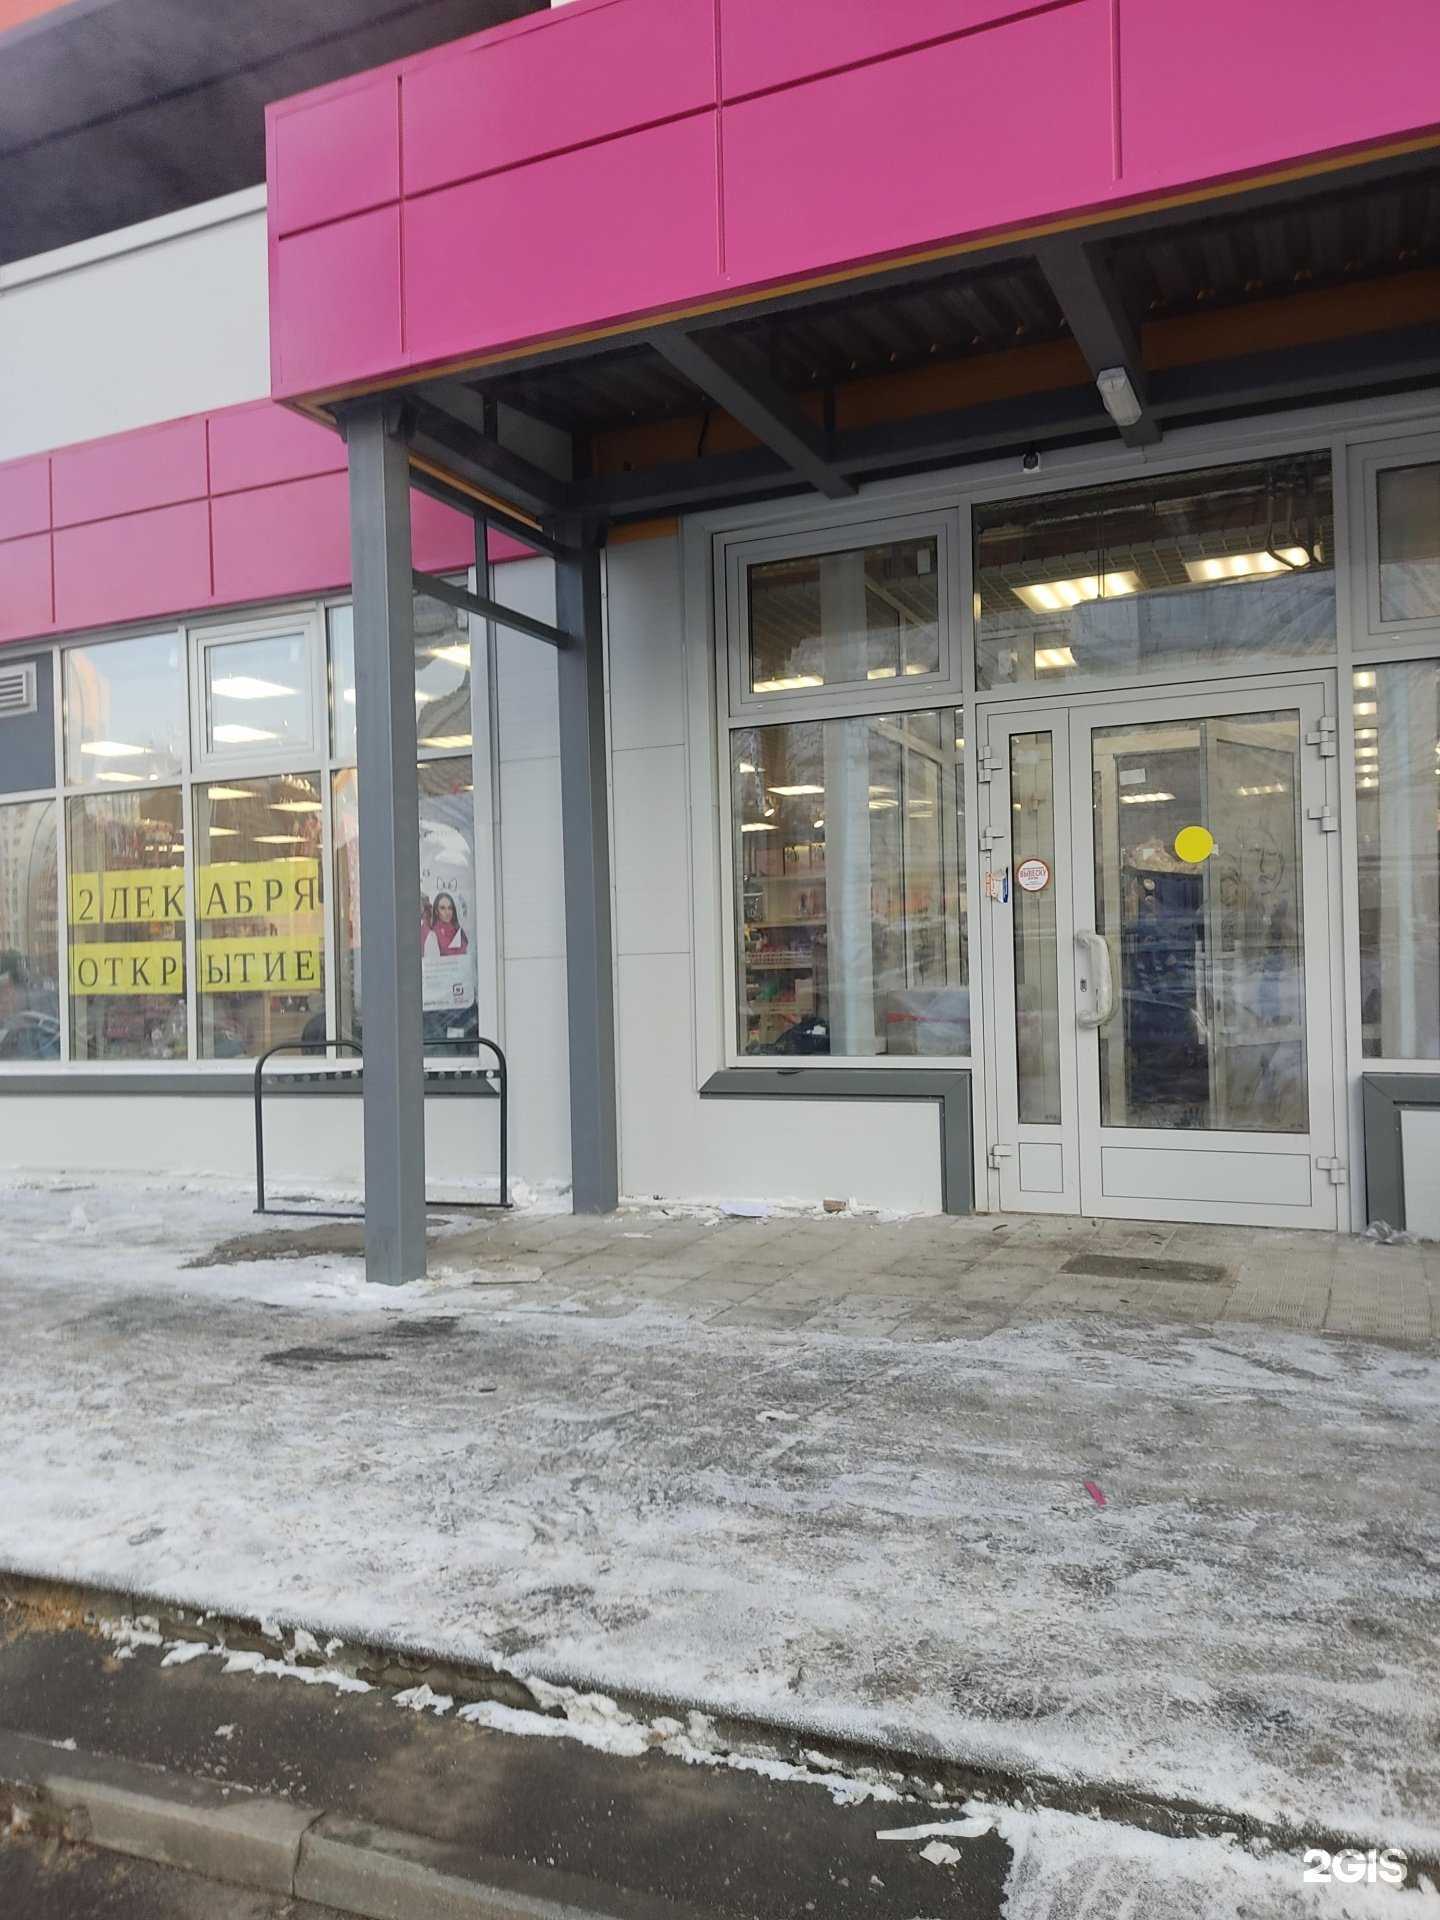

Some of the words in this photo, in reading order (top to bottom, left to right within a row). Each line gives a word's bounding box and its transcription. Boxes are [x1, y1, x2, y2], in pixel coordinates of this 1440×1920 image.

[79, 888, 94, 921] 2
[110, 876, 317, 920] ДЕКАБРЯ
[78, 949, 316, 987] ОТКРЫТИЕ
